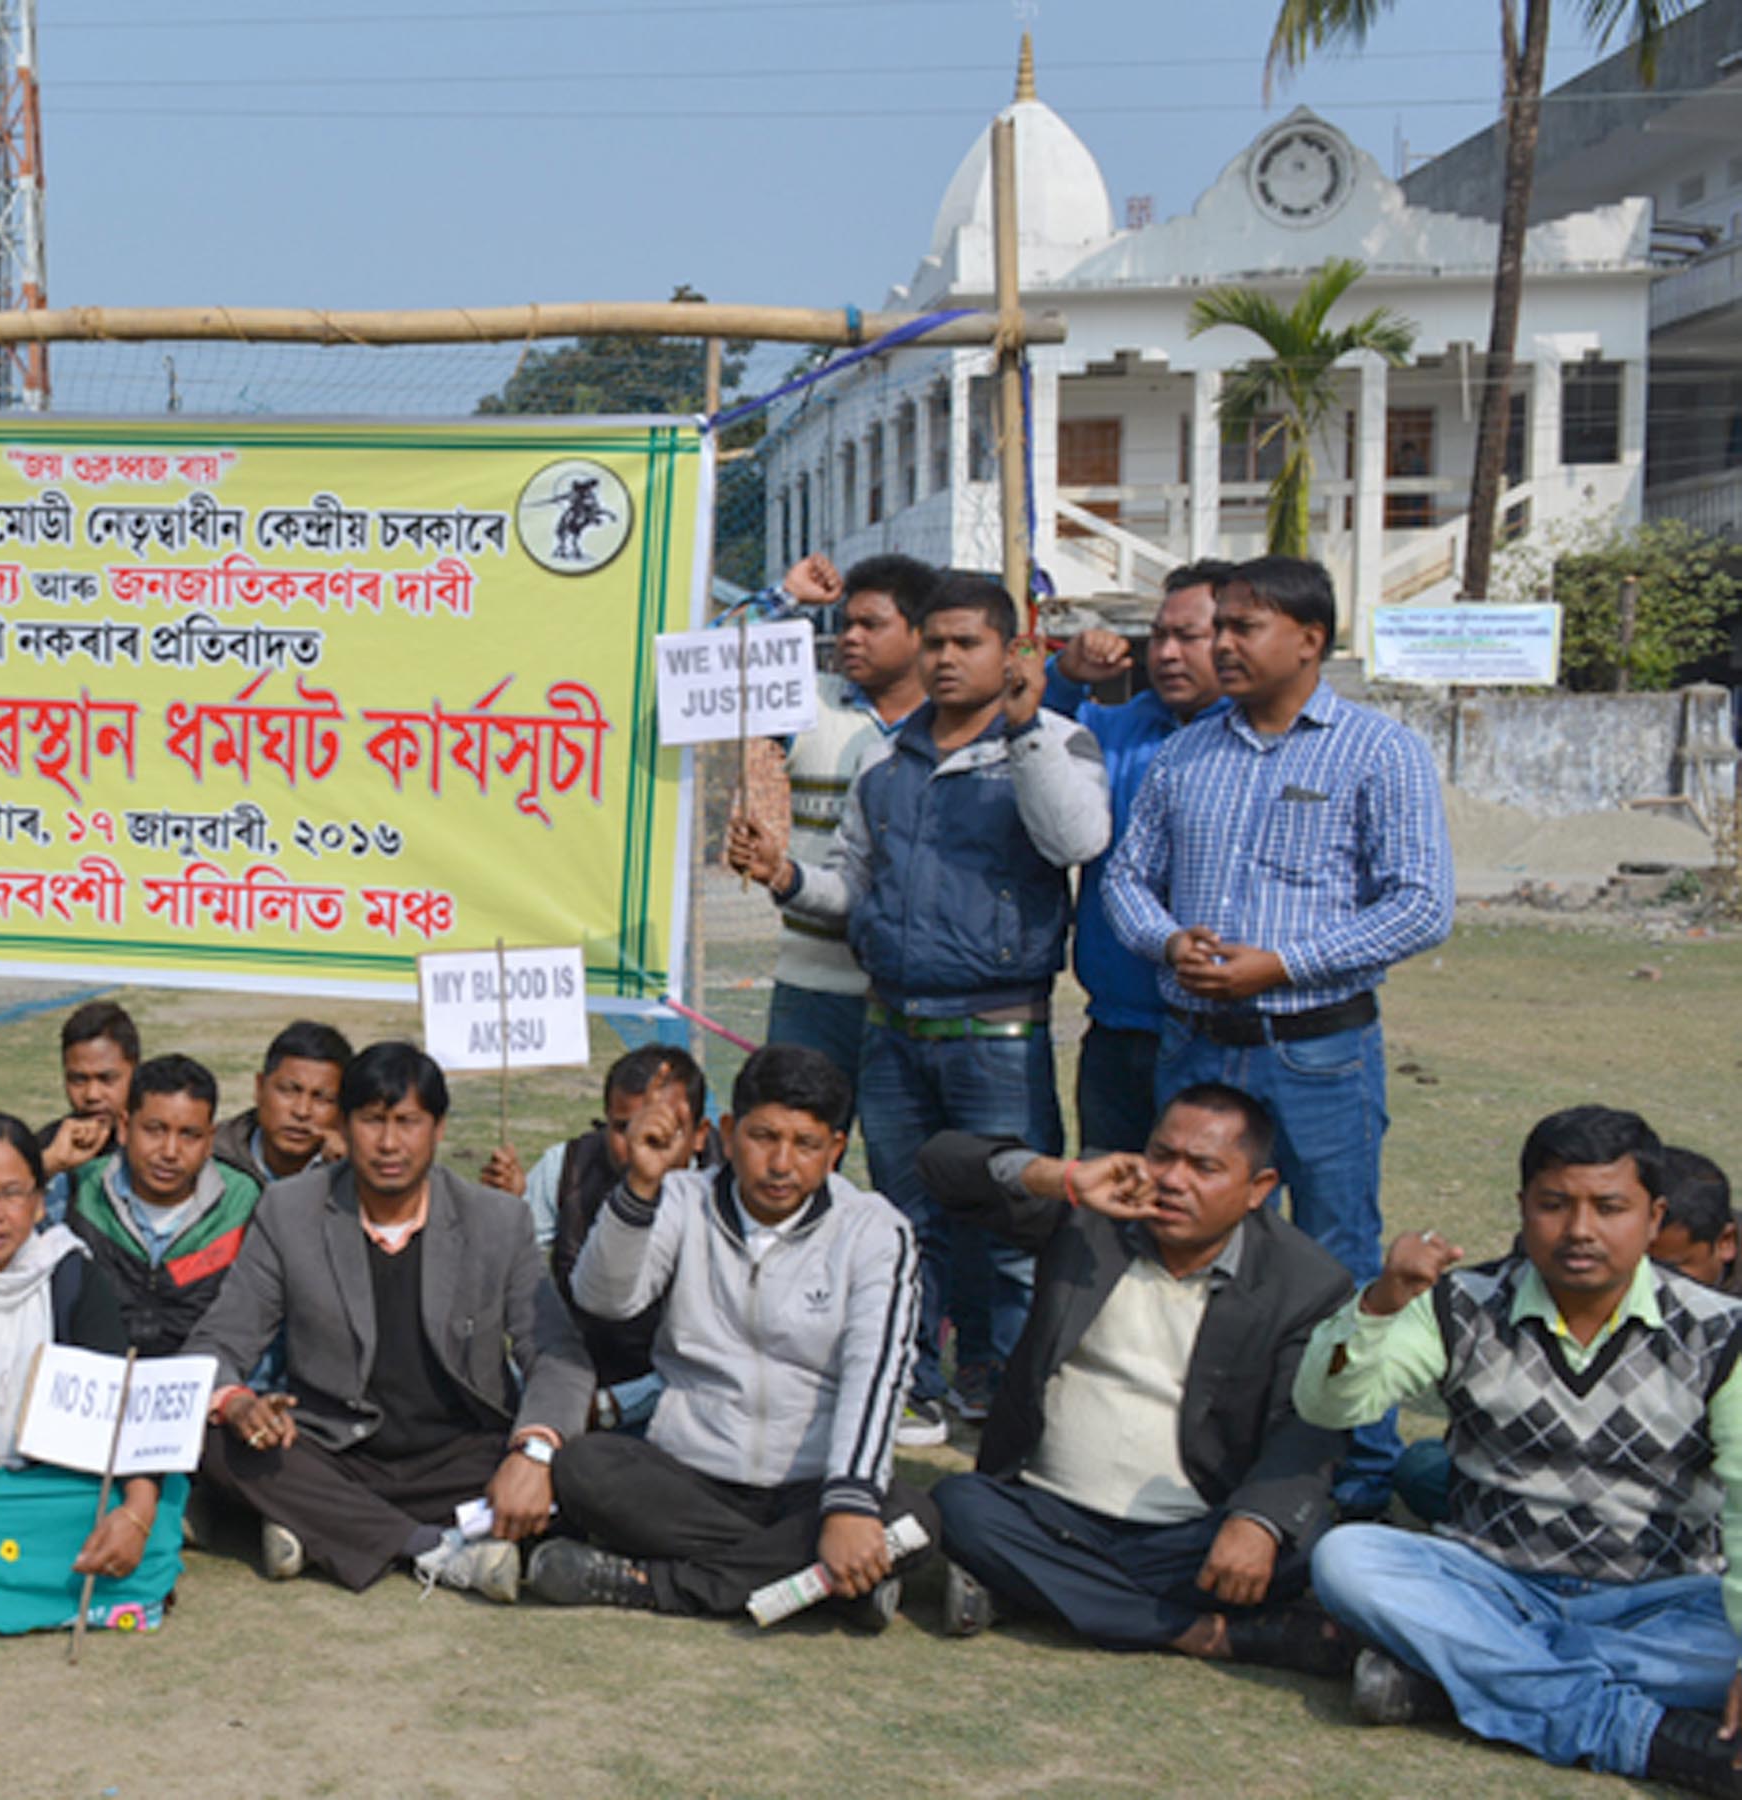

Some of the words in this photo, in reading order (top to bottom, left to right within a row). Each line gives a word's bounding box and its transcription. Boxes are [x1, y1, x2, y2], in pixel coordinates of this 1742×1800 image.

[394, 557, 474, 613] দাবী
[665, 646, 711, 677] WE
[719, 637, 803, 671] WANT
[680, 680, 802, 719] JUSTICE
[66, 811, 114, 844] ১৭
[294, 820, 402, 857] ২০১৬
[362, 889, 454, 939] মঞ্চ
[432, 970, 465, 1004] MY
[471, 967, 546, 1002] BLOOD
[553, 965, 575, 998] IS
